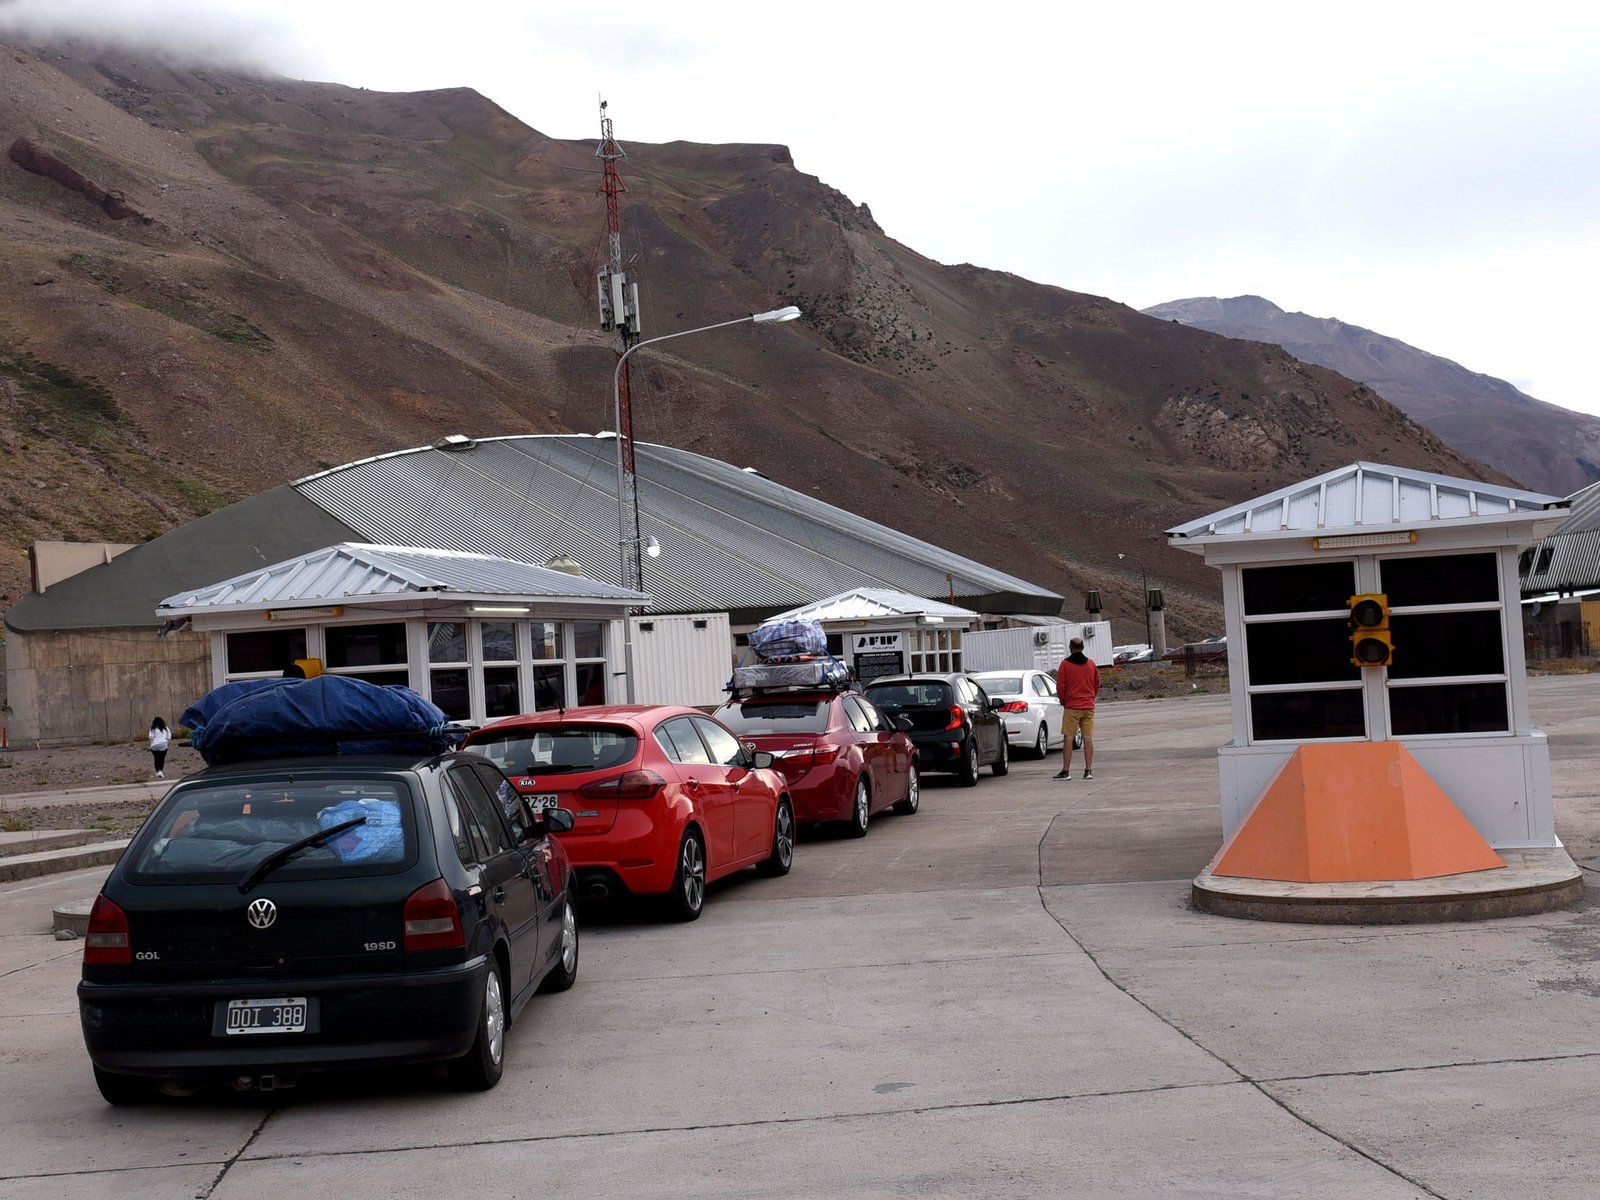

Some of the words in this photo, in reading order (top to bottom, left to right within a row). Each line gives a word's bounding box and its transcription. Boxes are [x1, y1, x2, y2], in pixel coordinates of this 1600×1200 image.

[858, 635, 898, 648] AFIP
[136, 951, 160, 960] GOL
[231, 1008, 262, 1027] DOI
[272, 1007, 302, 1026] 388
